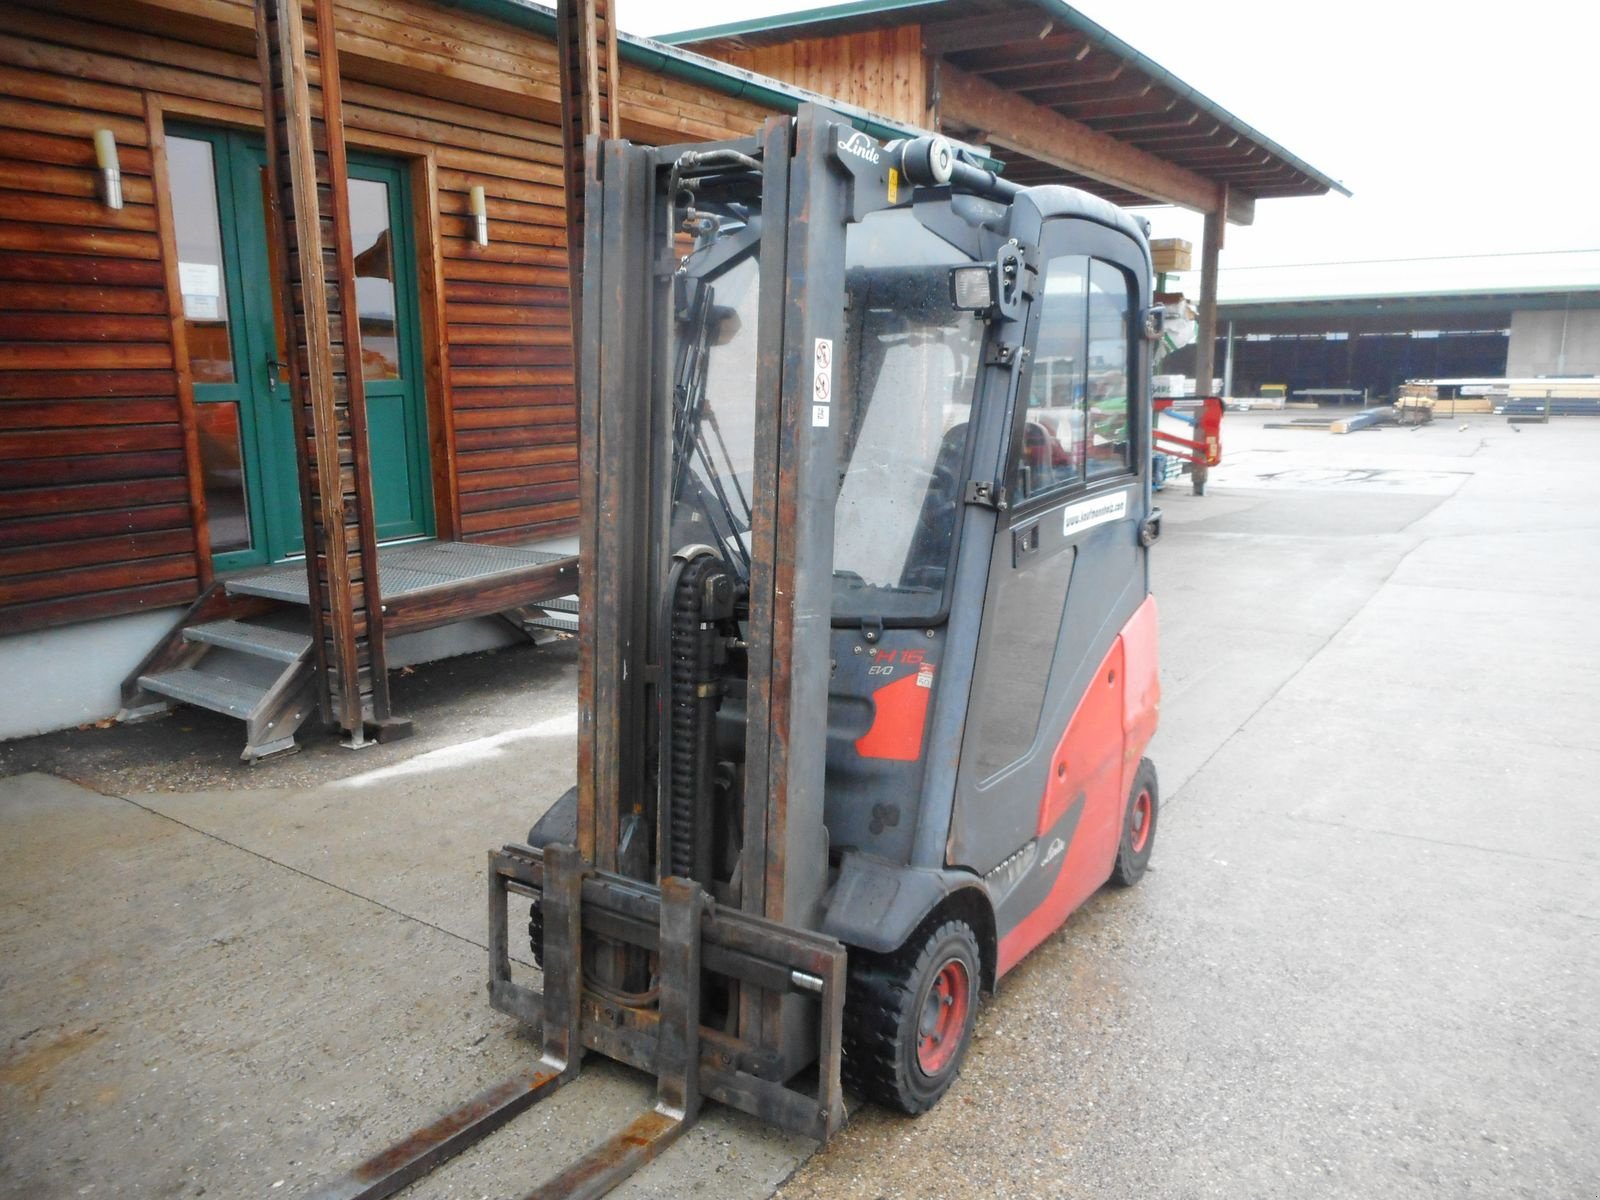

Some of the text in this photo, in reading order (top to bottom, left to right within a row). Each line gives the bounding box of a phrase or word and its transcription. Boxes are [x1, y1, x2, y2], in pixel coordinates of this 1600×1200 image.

[838, 132, 880, 165] Linde
[875, 649, 898, 665] H
[868, 665, 894, 676] EVO
